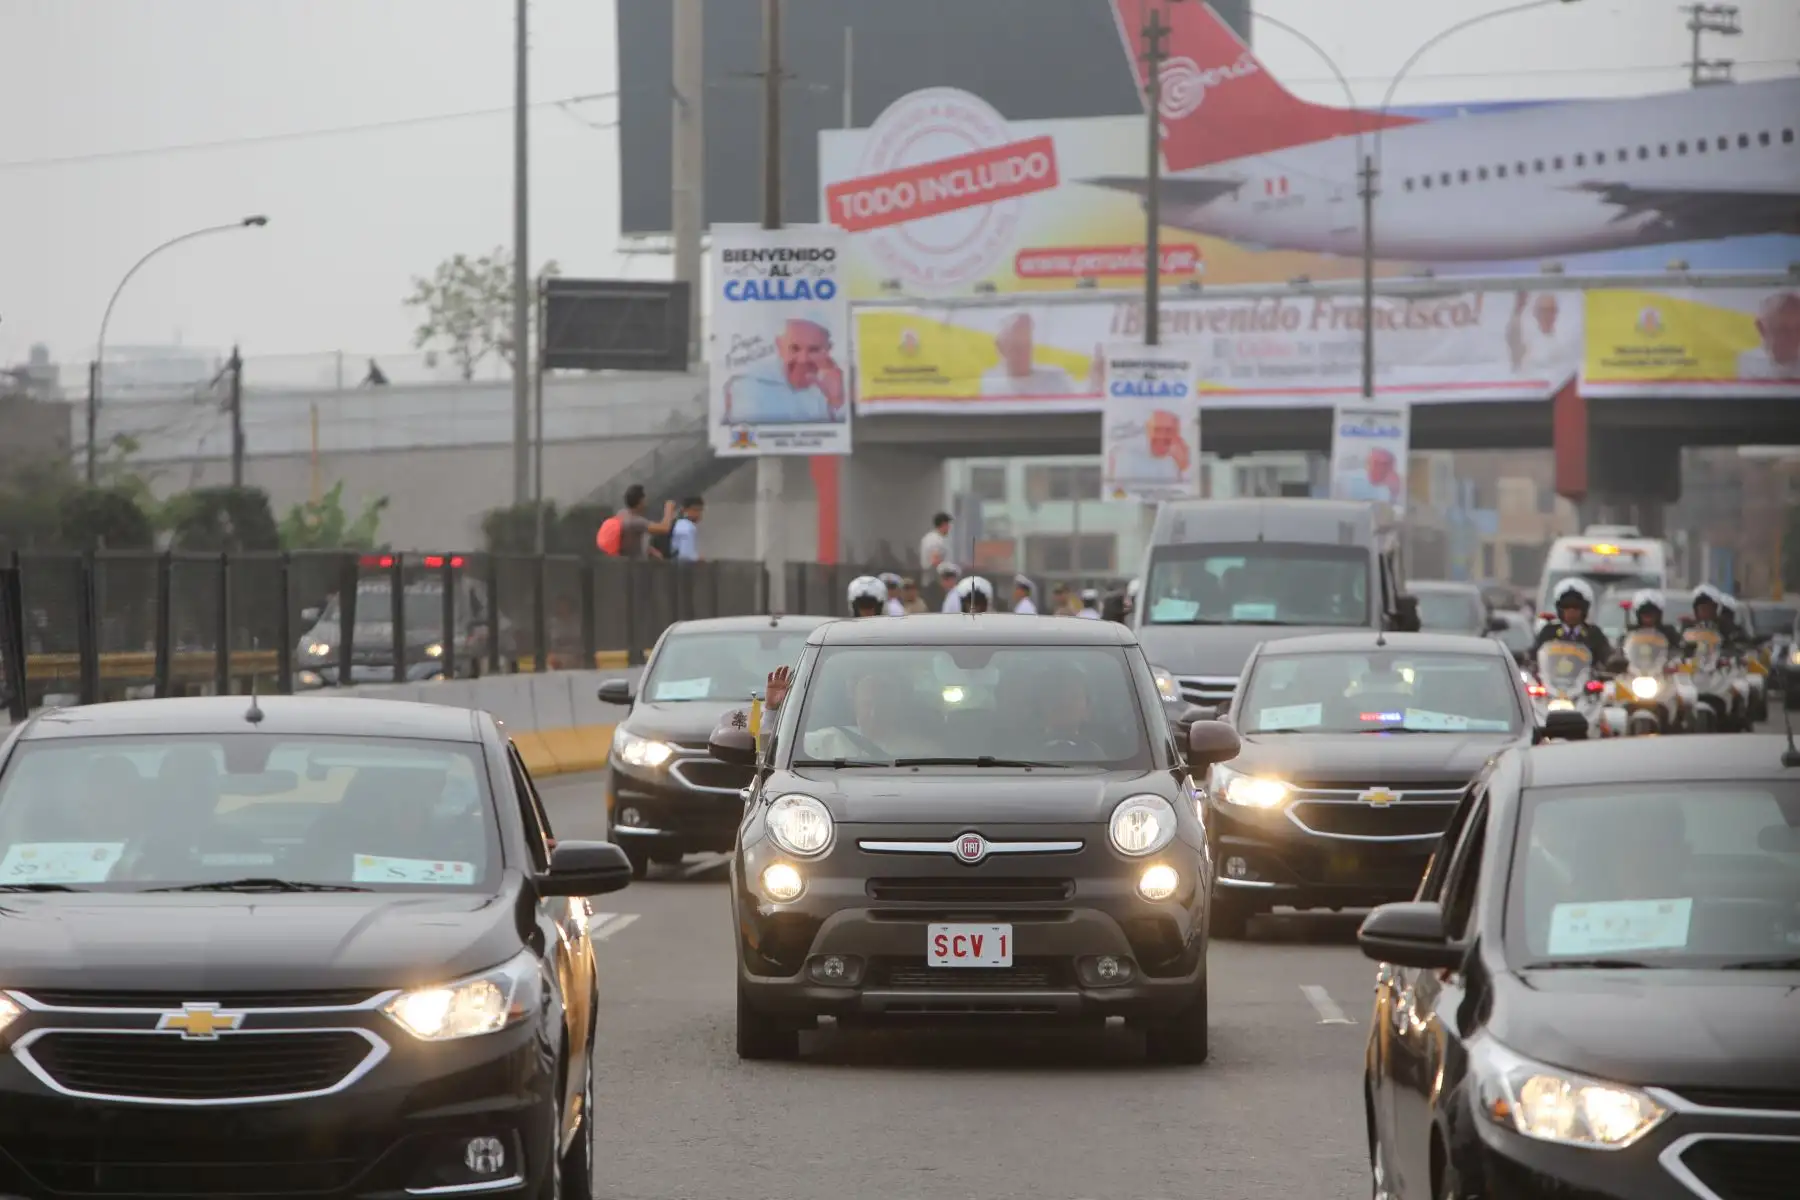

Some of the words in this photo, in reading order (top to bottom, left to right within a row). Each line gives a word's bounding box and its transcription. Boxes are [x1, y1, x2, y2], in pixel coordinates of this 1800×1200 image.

[836, 183, 917, 219] TODO
[918, 152, 1050, 204] INCLUIDO
[723, 247, 836, 262] BIENVENIDO
[769, 264, 792, 277] AL
[723, 279, 837, 301] CALLAO
[1110, 381, 1188, 397] CALLAO
[963, 842, 979, 854] FIAT
[934, 934, 984, 958] SCV
[998, 934, 1007, 958] 1
